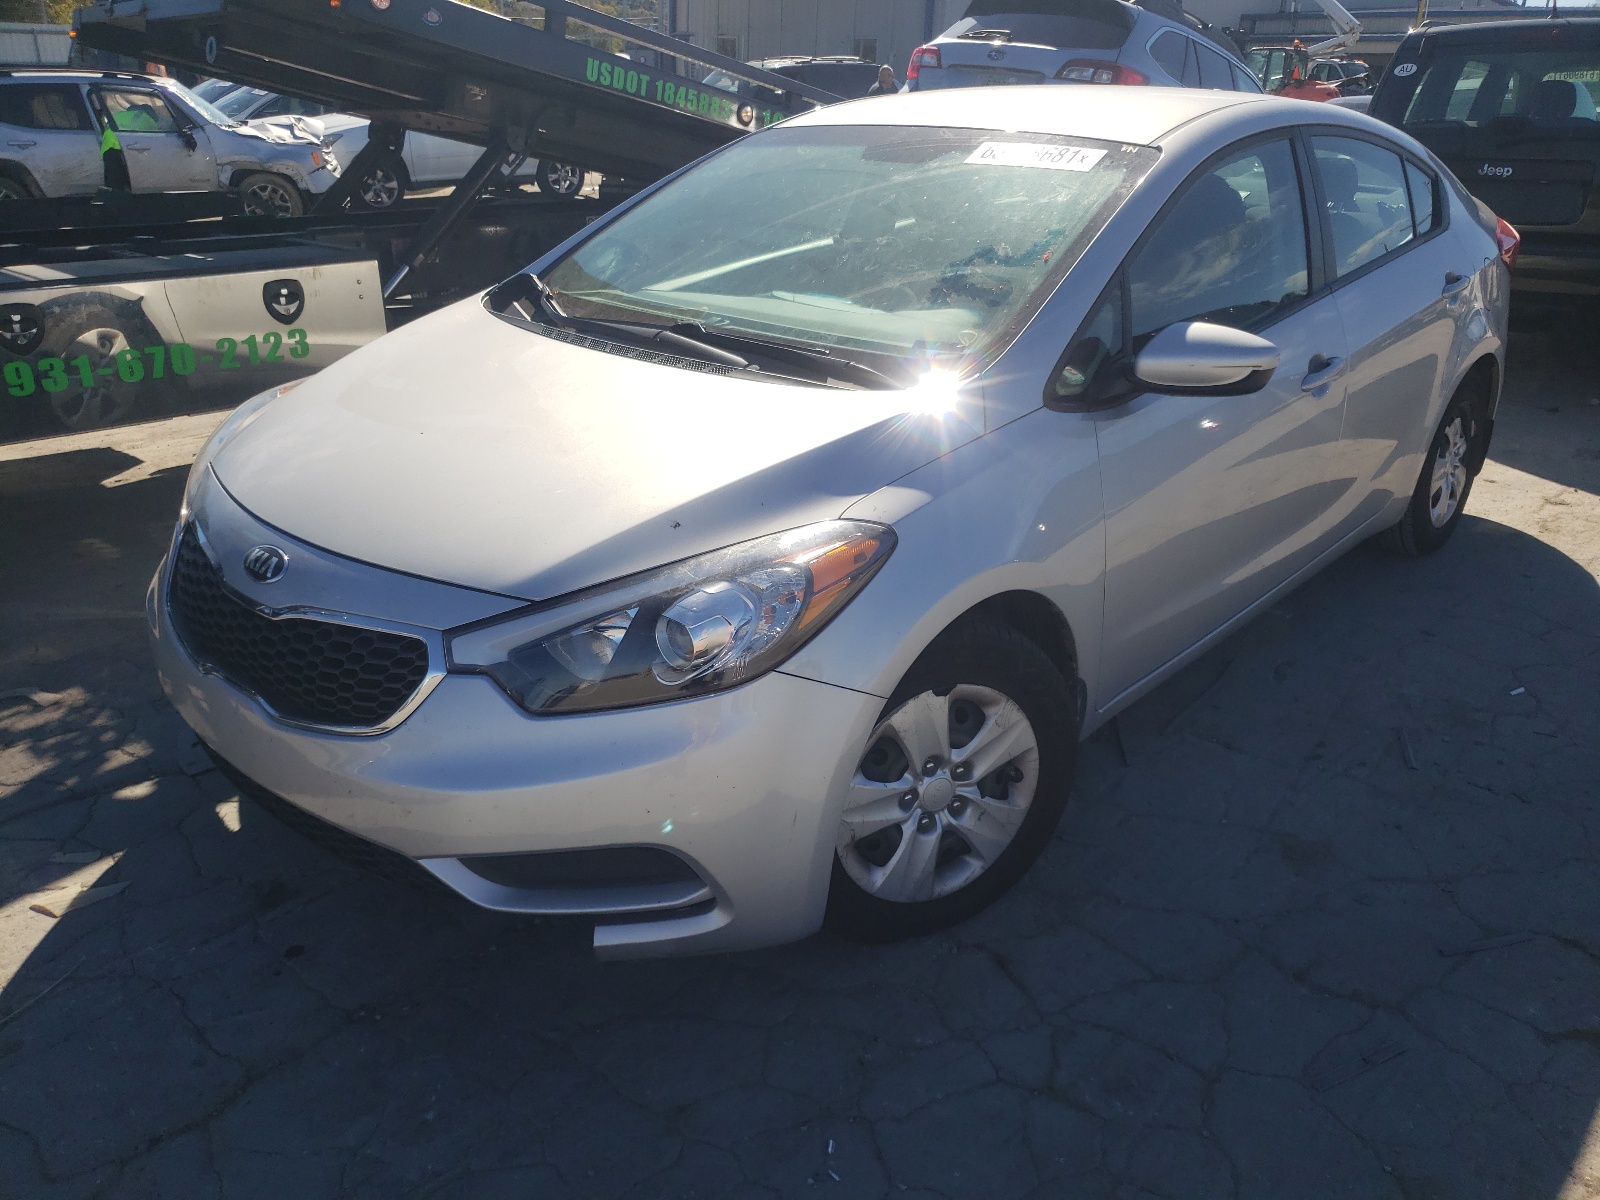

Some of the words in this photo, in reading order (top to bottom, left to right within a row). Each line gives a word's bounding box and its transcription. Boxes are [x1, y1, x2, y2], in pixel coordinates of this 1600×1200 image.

[586, 57, 650, 97] USDOT
[1398, 64, 1414, 74] AU
[1478, 163, 1513, 178] Jeep
[3, 328, 310, 397] 931-670-2123
